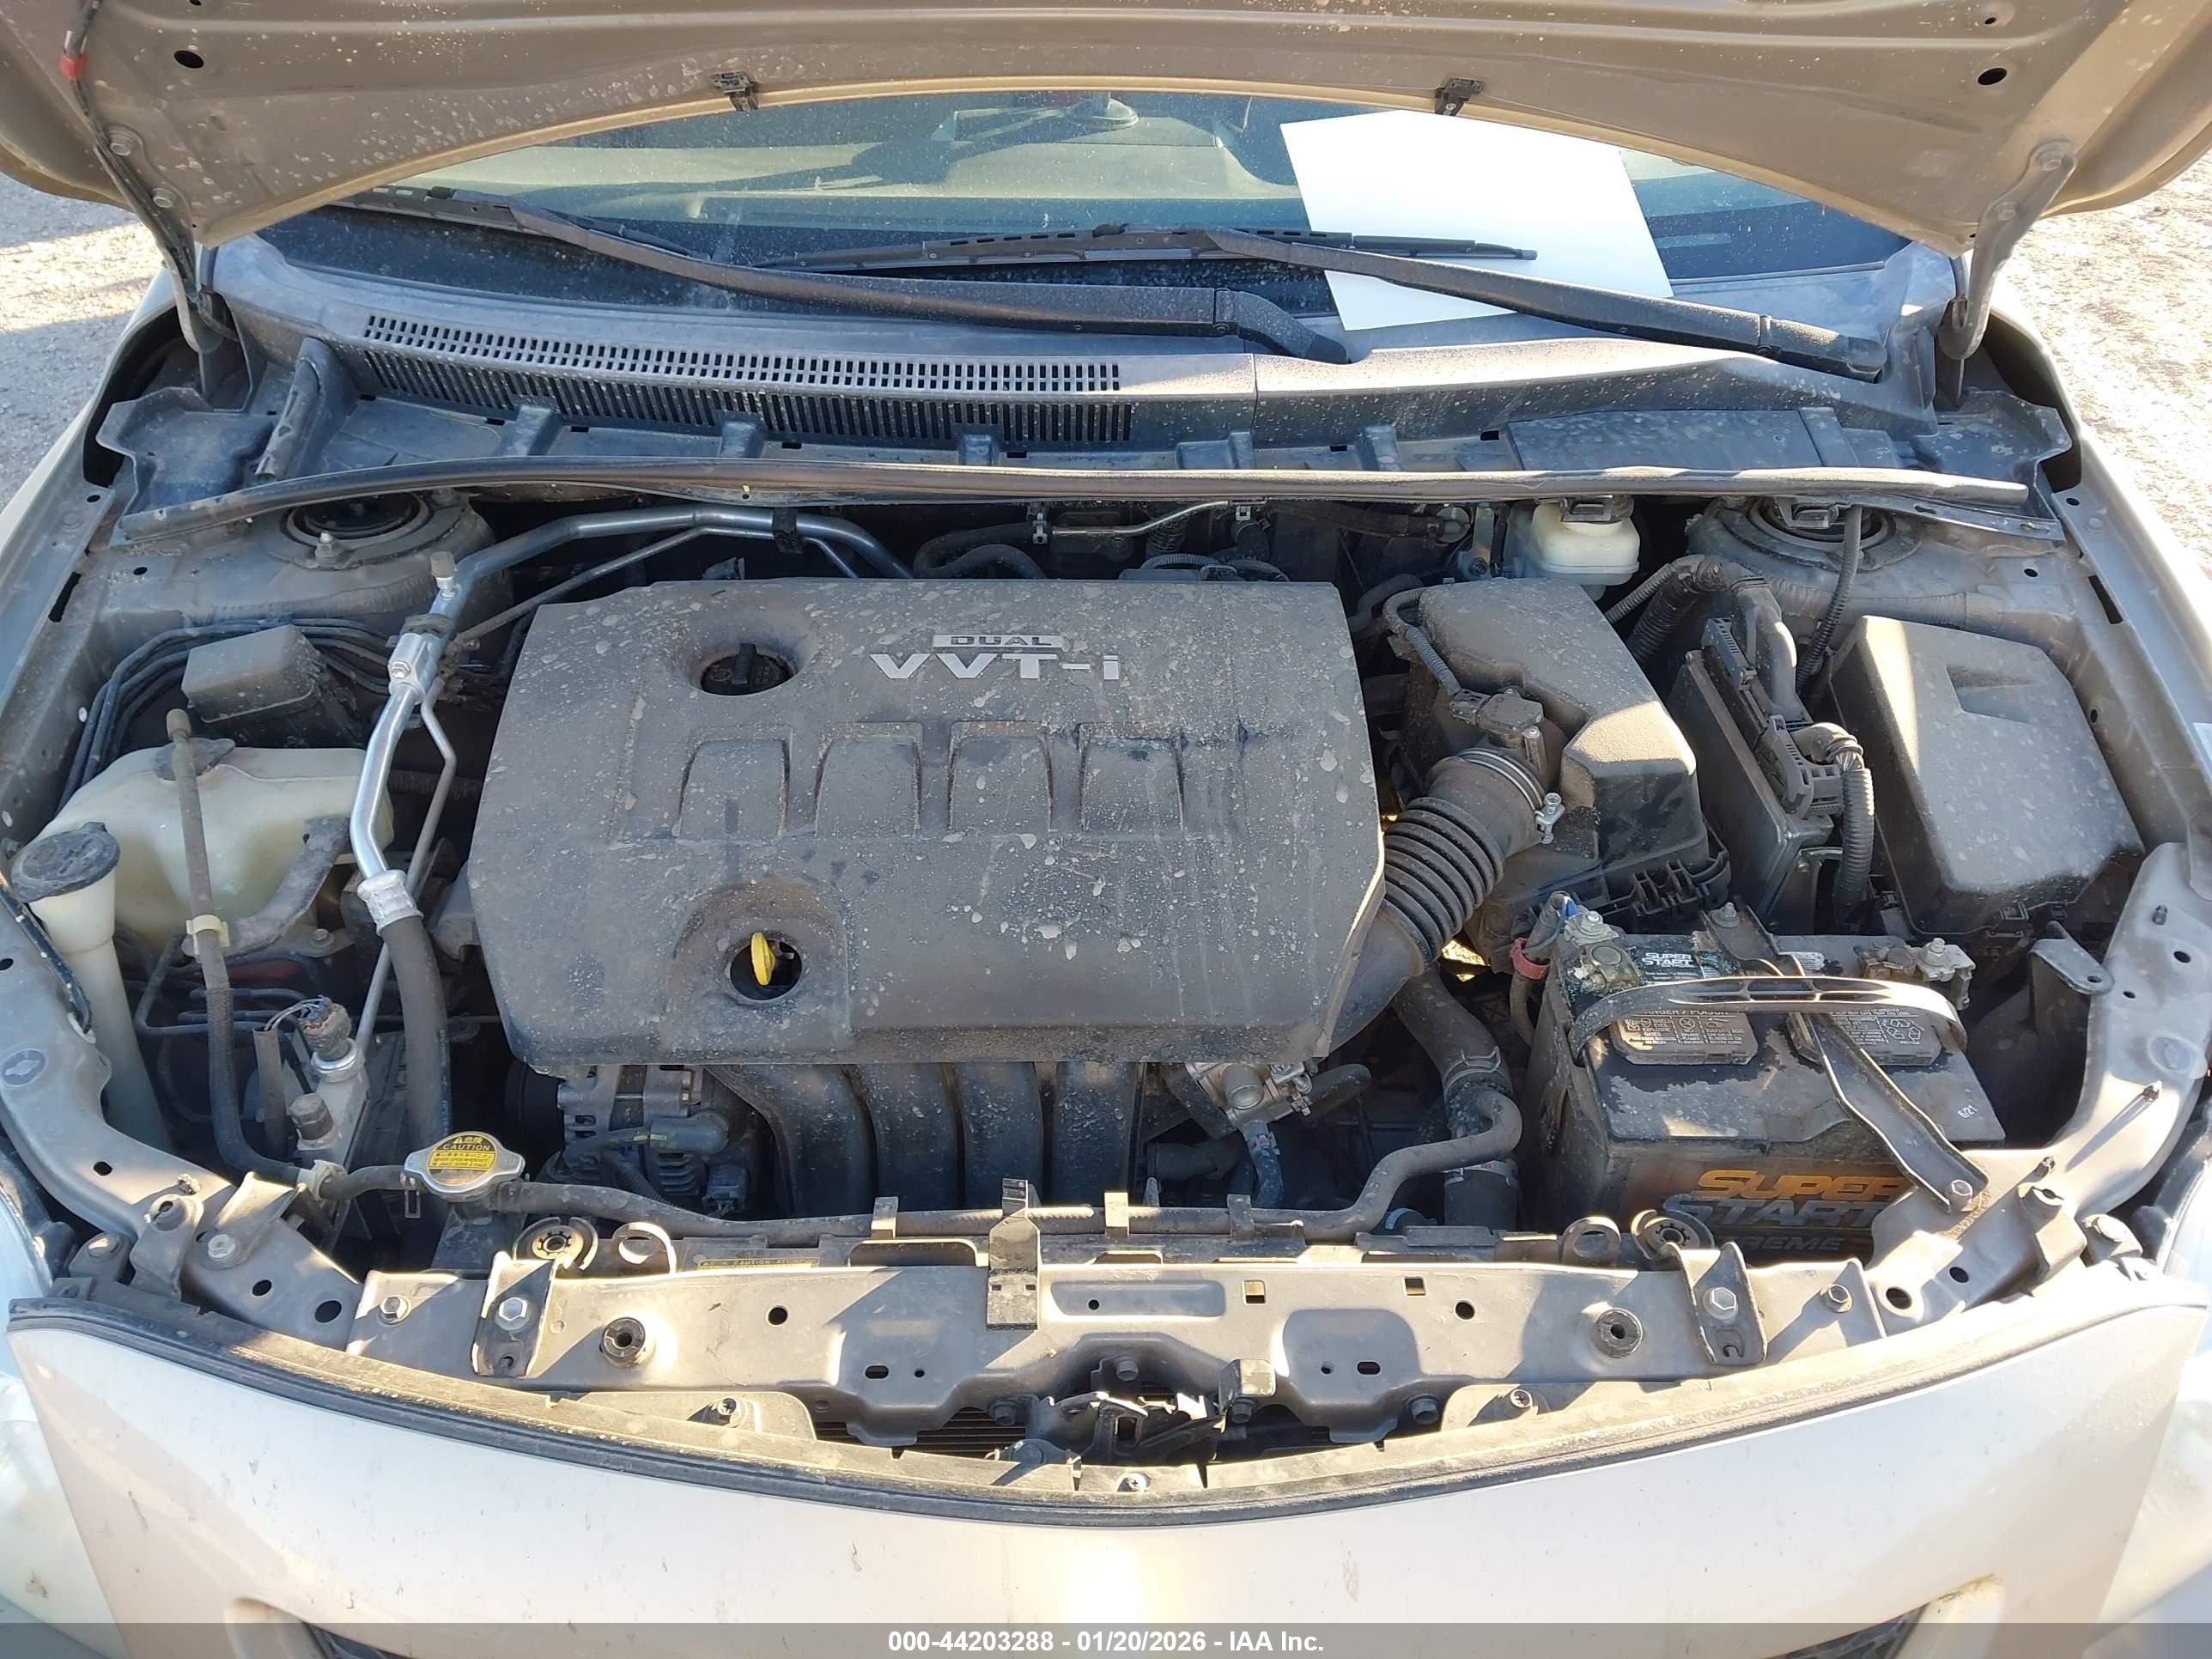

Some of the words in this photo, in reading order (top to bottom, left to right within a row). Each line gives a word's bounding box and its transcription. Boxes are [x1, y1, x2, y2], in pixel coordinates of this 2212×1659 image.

[950, 635, 1053, 647] DUAL
[869, 653, 1120, 680] VVT-i
[1698, 1170, 1907, 1202] SUPER
[1662, 1194, 1885, 1228] START
